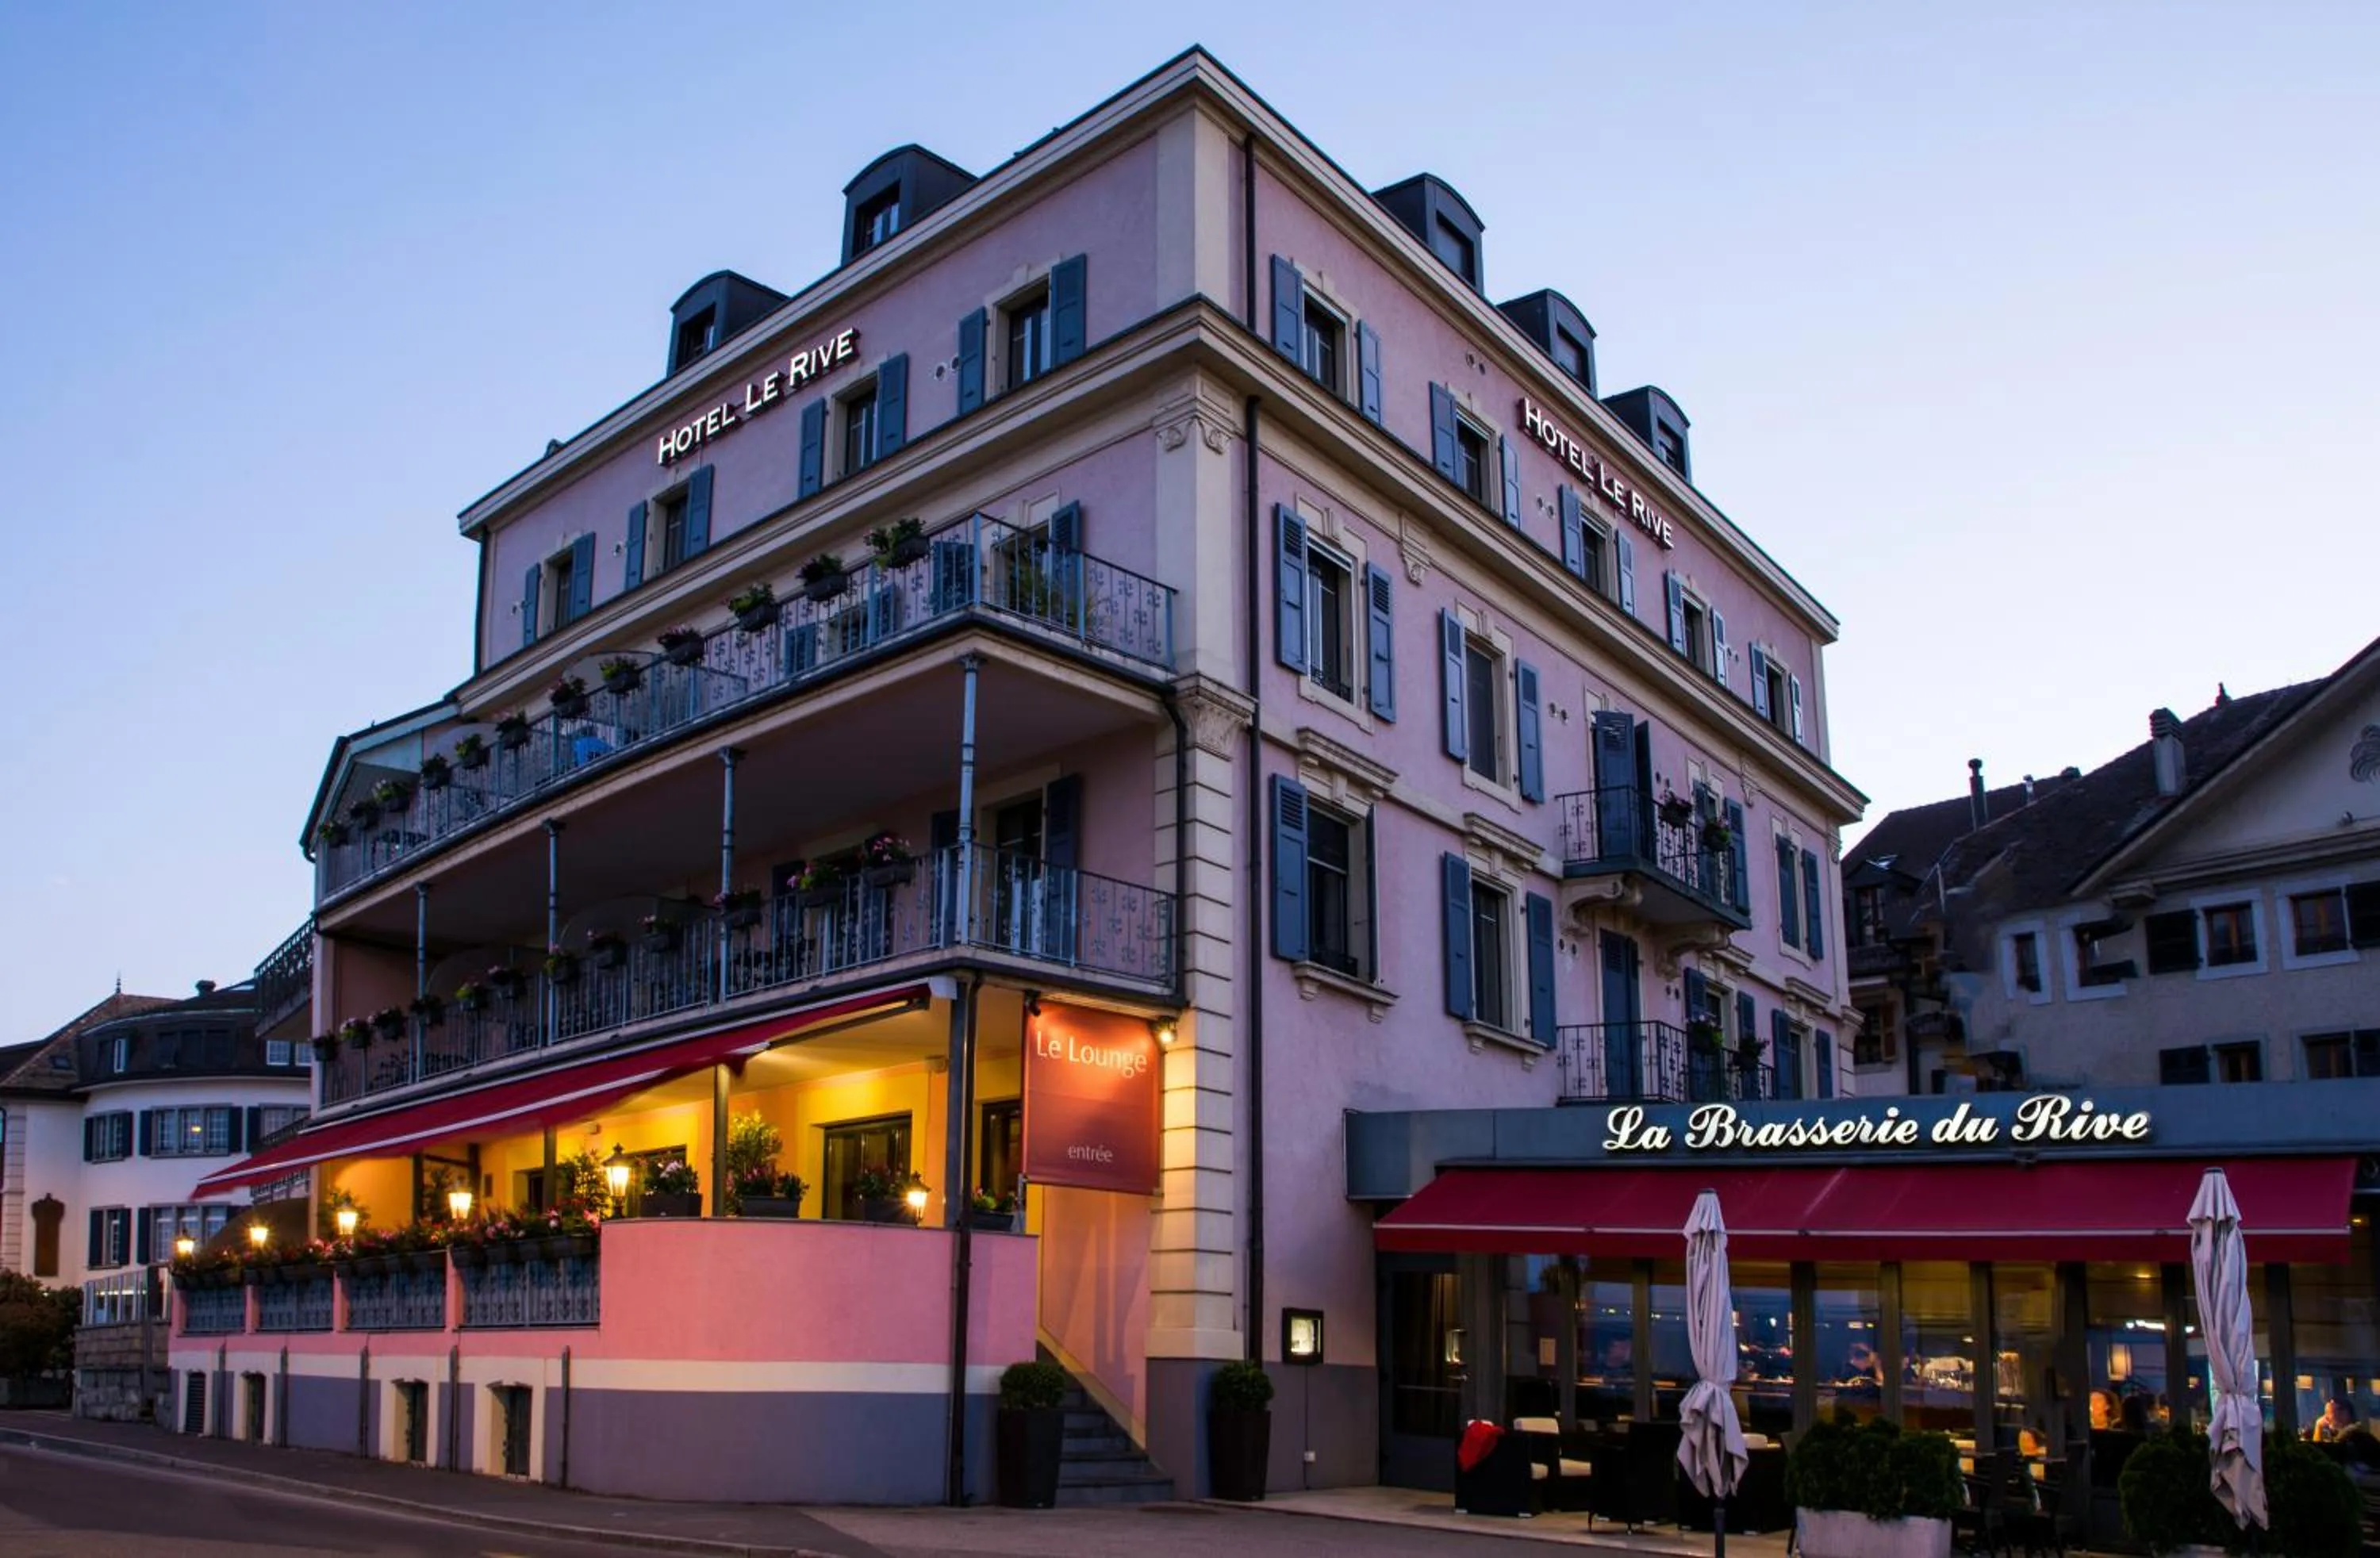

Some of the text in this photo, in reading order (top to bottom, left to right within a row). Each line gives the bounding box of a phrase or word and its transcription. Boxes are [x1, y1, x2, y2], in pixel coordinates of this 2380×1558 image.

[658, 328, 854, 464] HOTEL LE RIVE
[1524, 397, 1674, 549] HOTEL LE RIVE
[1036, 1030, 1147, 1079] Le Lounge
[1602, 1094, 2152, 1150] La Brasserie du Rive
[1068, 1144, 1114, 1163] entrée
